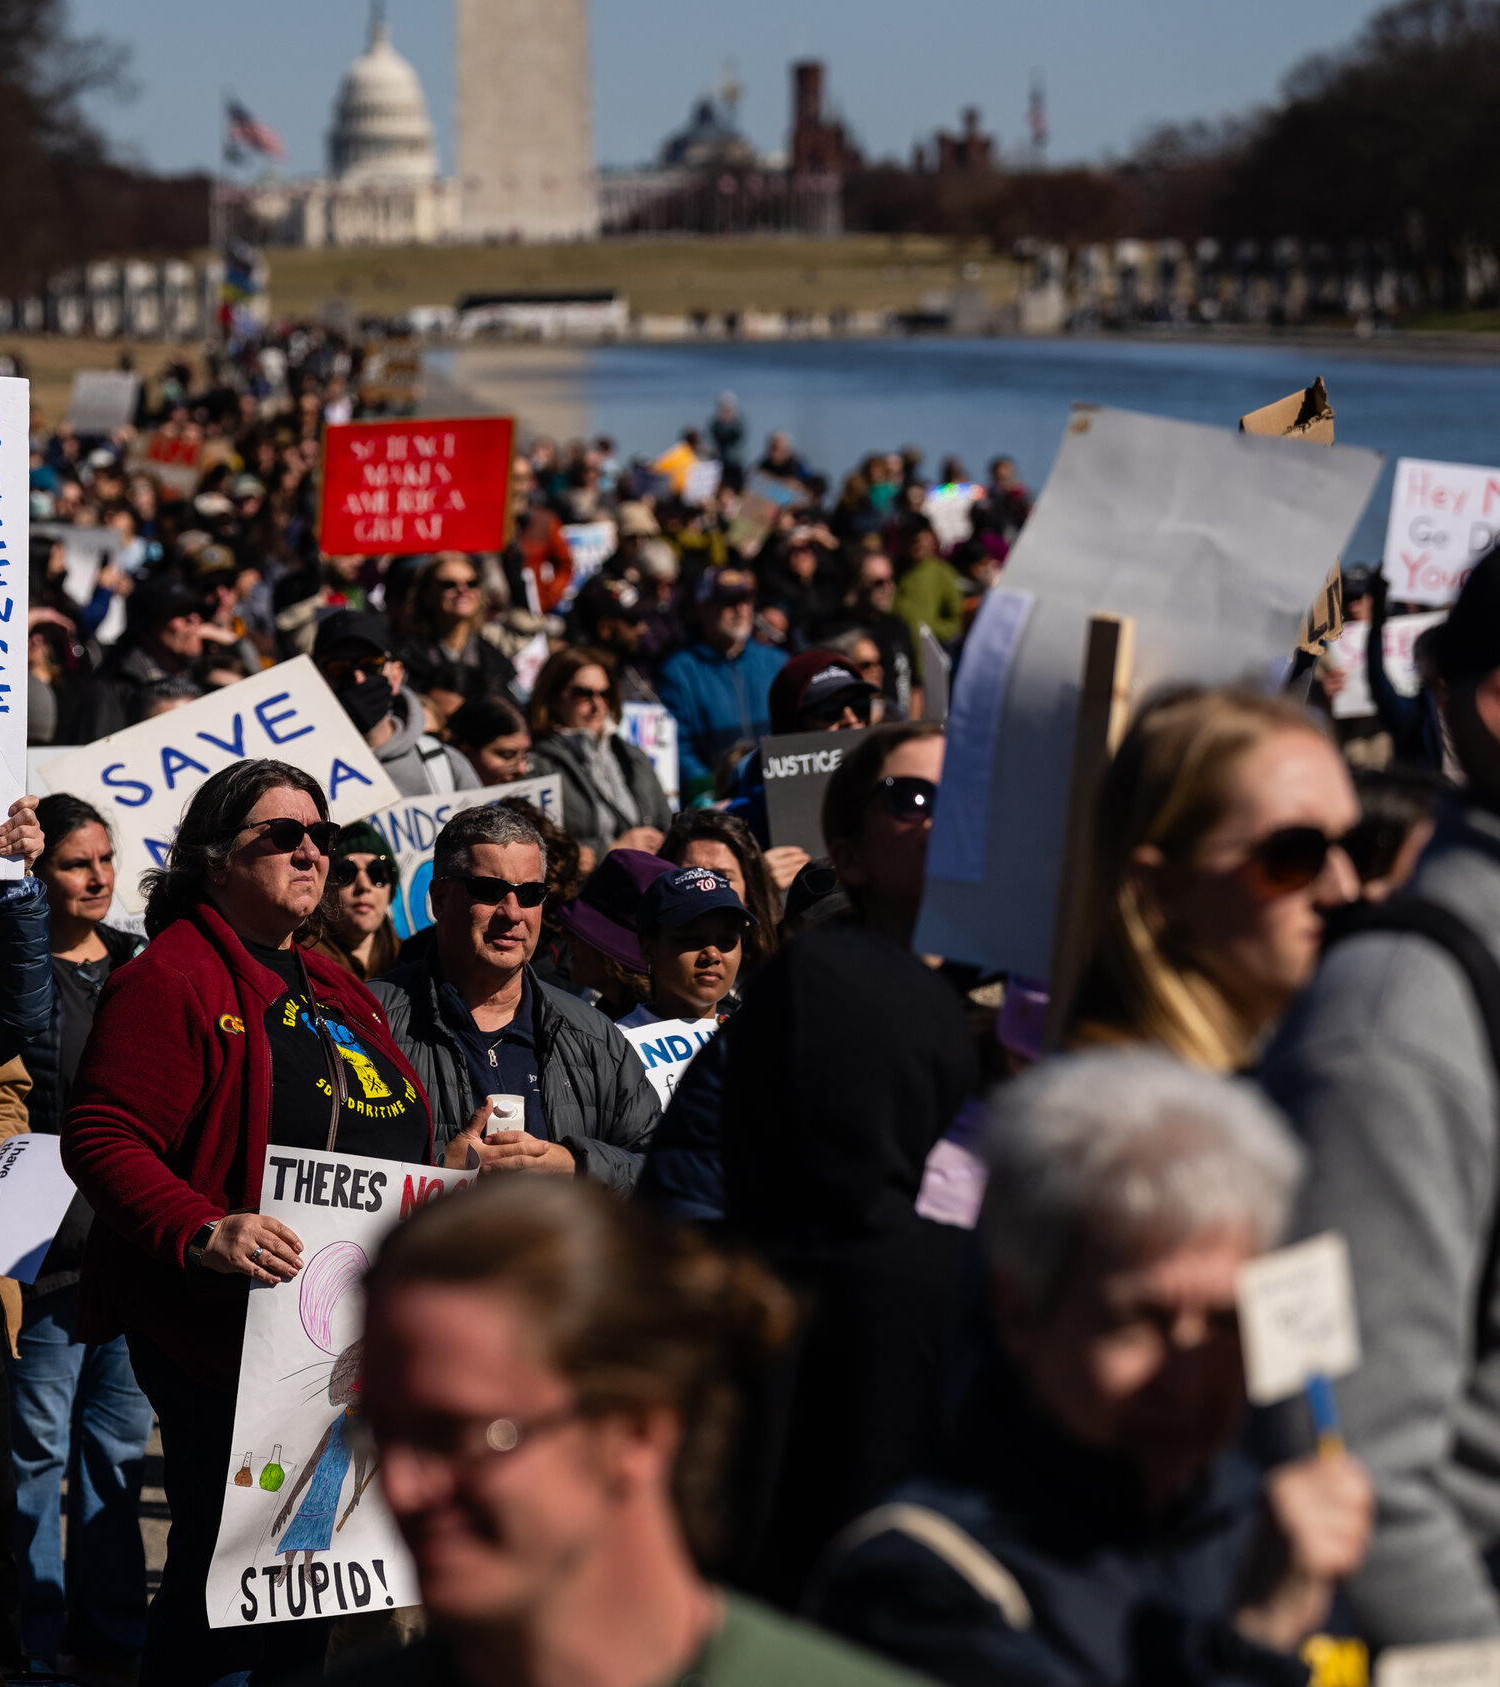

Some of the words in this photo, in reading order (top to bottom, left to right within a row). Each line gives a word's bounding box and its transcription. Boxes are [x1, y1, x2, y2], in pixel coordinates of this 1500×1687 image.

[1405, 467, 1469, 516] Hey
[1408, 514, 1451, 550] Go
[102, 692, 315, 807] SAVE
[763, 748, 843, 779] JUSTICE
[240, 1559, 394, 1622] STUPID!
